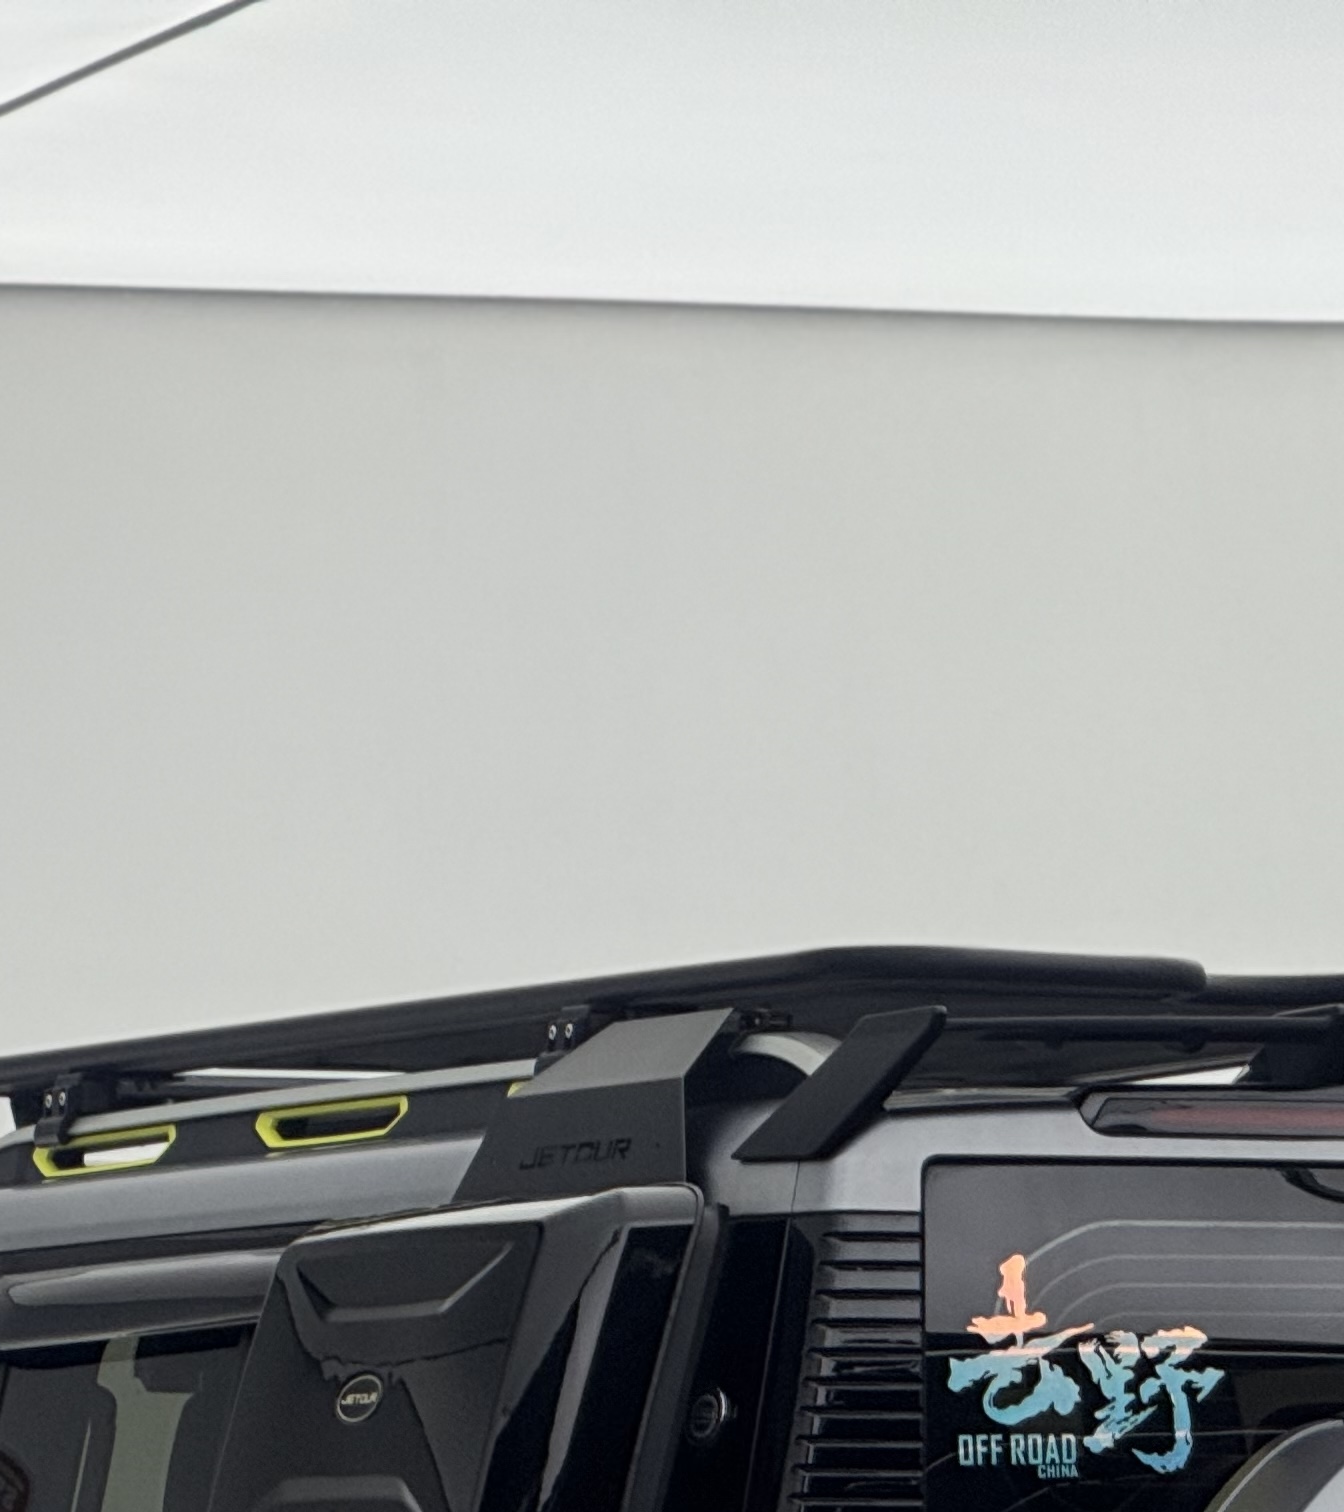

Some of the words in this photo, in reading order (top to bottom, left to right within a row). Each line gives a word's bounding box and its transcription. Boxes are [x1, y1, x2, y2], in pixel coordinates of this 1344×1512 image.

[519, 1138, 632, 1171] JETOUR
[958, 1433, 1003, 1467] OFF
[1010, 1433, 1078, 1467] ROAD
[1037, 1463, 1080, 1480] CHINA
